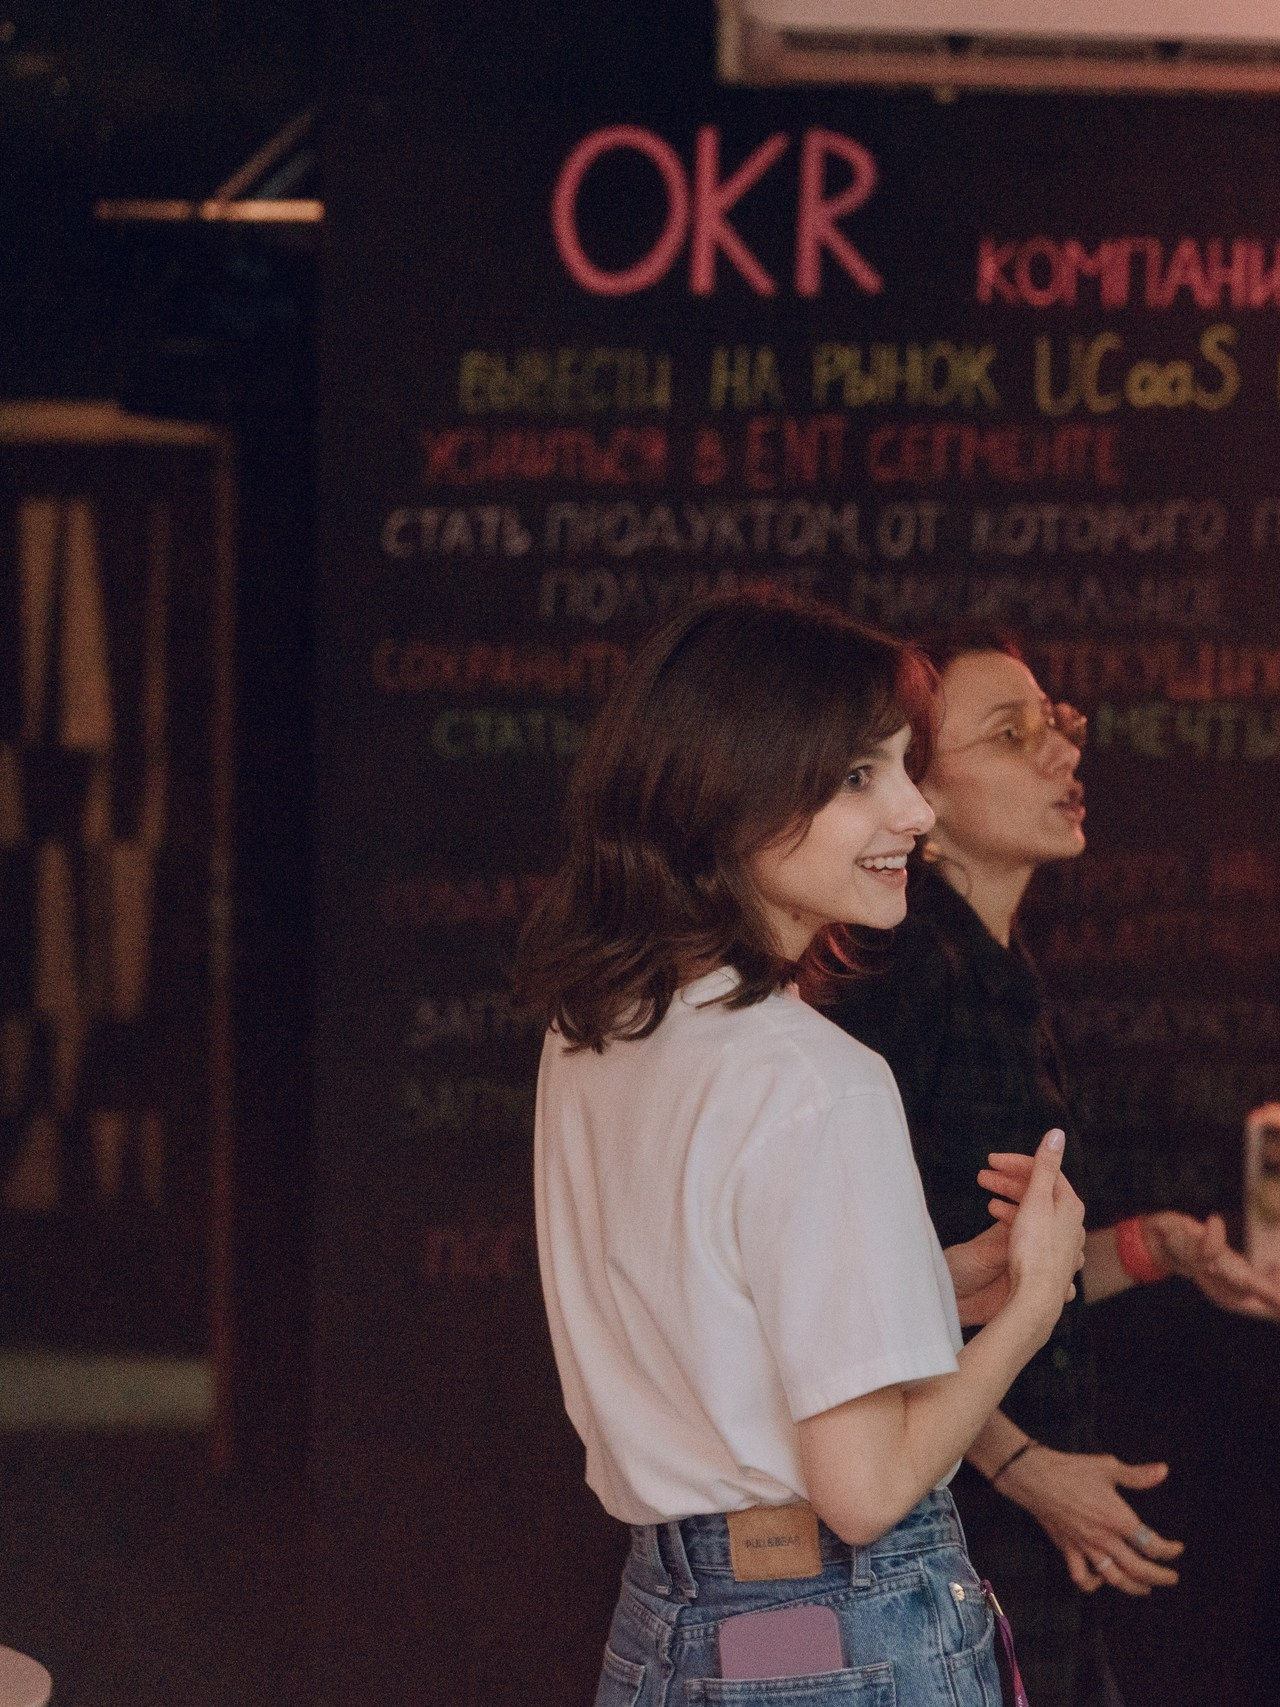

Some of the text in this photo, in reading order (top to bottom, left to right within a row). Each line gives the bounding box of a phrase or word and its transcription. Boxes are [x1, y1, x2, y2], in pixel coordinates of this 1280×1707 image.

[550, 122, 885, 298] OKR
[711, 344, 785, 410] НА
[811, 340, 1000, 408] РЫНОК
[1034, 322, 1242, 416] UCaaS
[380, 506, 530, 558] СТАТЬ
[878, 502, 944, 558] ОТ
